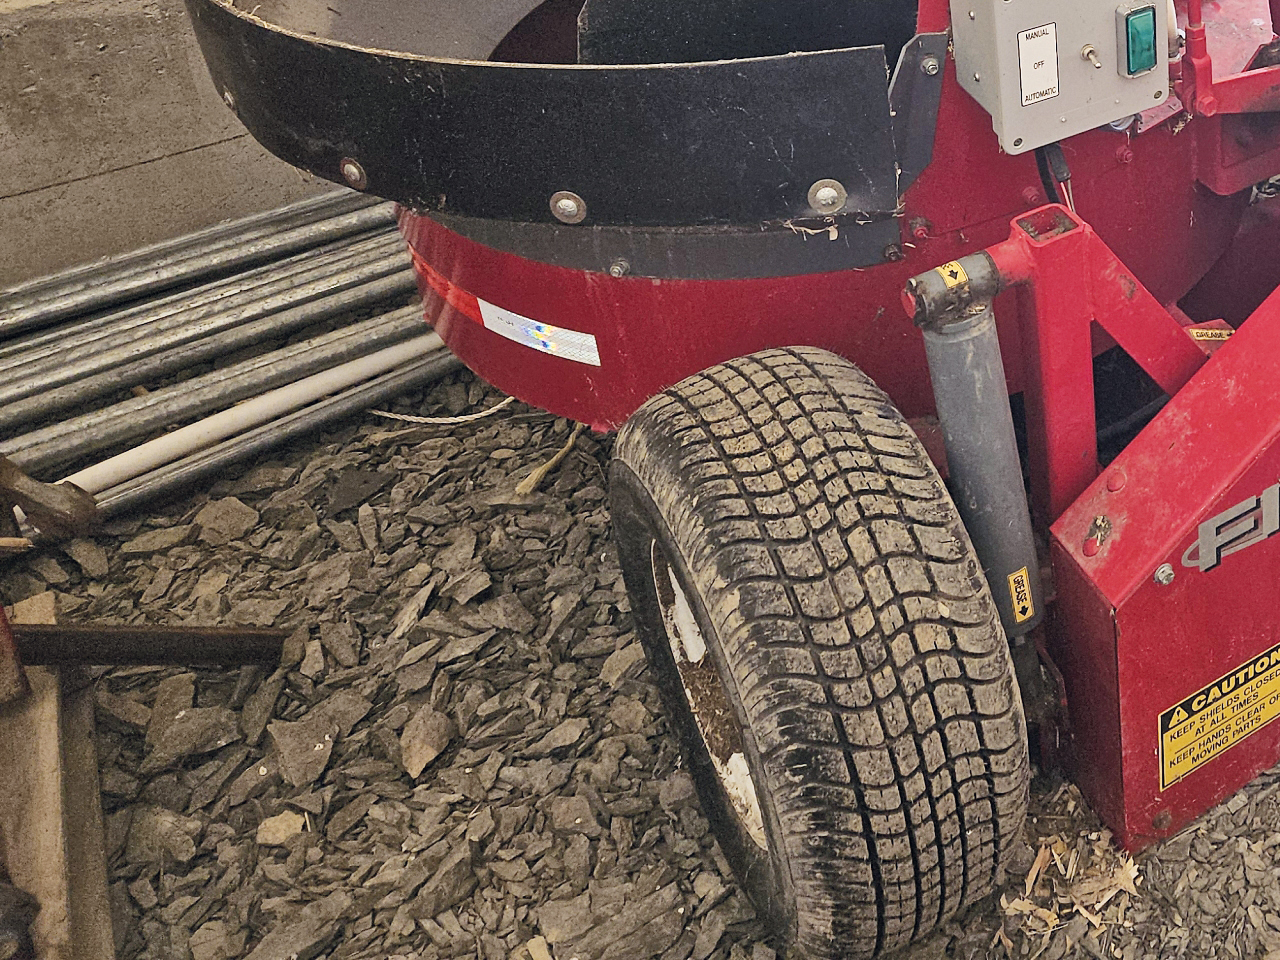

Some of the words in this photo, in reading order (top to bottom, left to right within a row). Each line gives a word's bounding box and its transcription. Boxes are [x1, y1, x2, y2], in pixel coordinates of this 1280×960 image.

[1025, 28, 1050, 41] MANUAL
[1033, 60, 1045, 70] OFF
[1025, 86, 1057, 103] AUTOMATIC
[1013, 574, 1028, 606] GREASE
[1169, 720, 1195, 742] KEEP
[1199, 693, 1240, 723] SHIELDS
[1194, 724, 1207, 737] AT
[1209, 713, 1227, 728] ALL
[1231, 691, 1259, 714] TIMES
[1169, 746, 1195, 769] KEEP
[1198, 724, 1231, 750] HANDS
[1235, 702, 1266, 726] CLEAR
[1191, 736, 1229, 764] MOVING
[1232, 714, 1261, 739] PARTS
